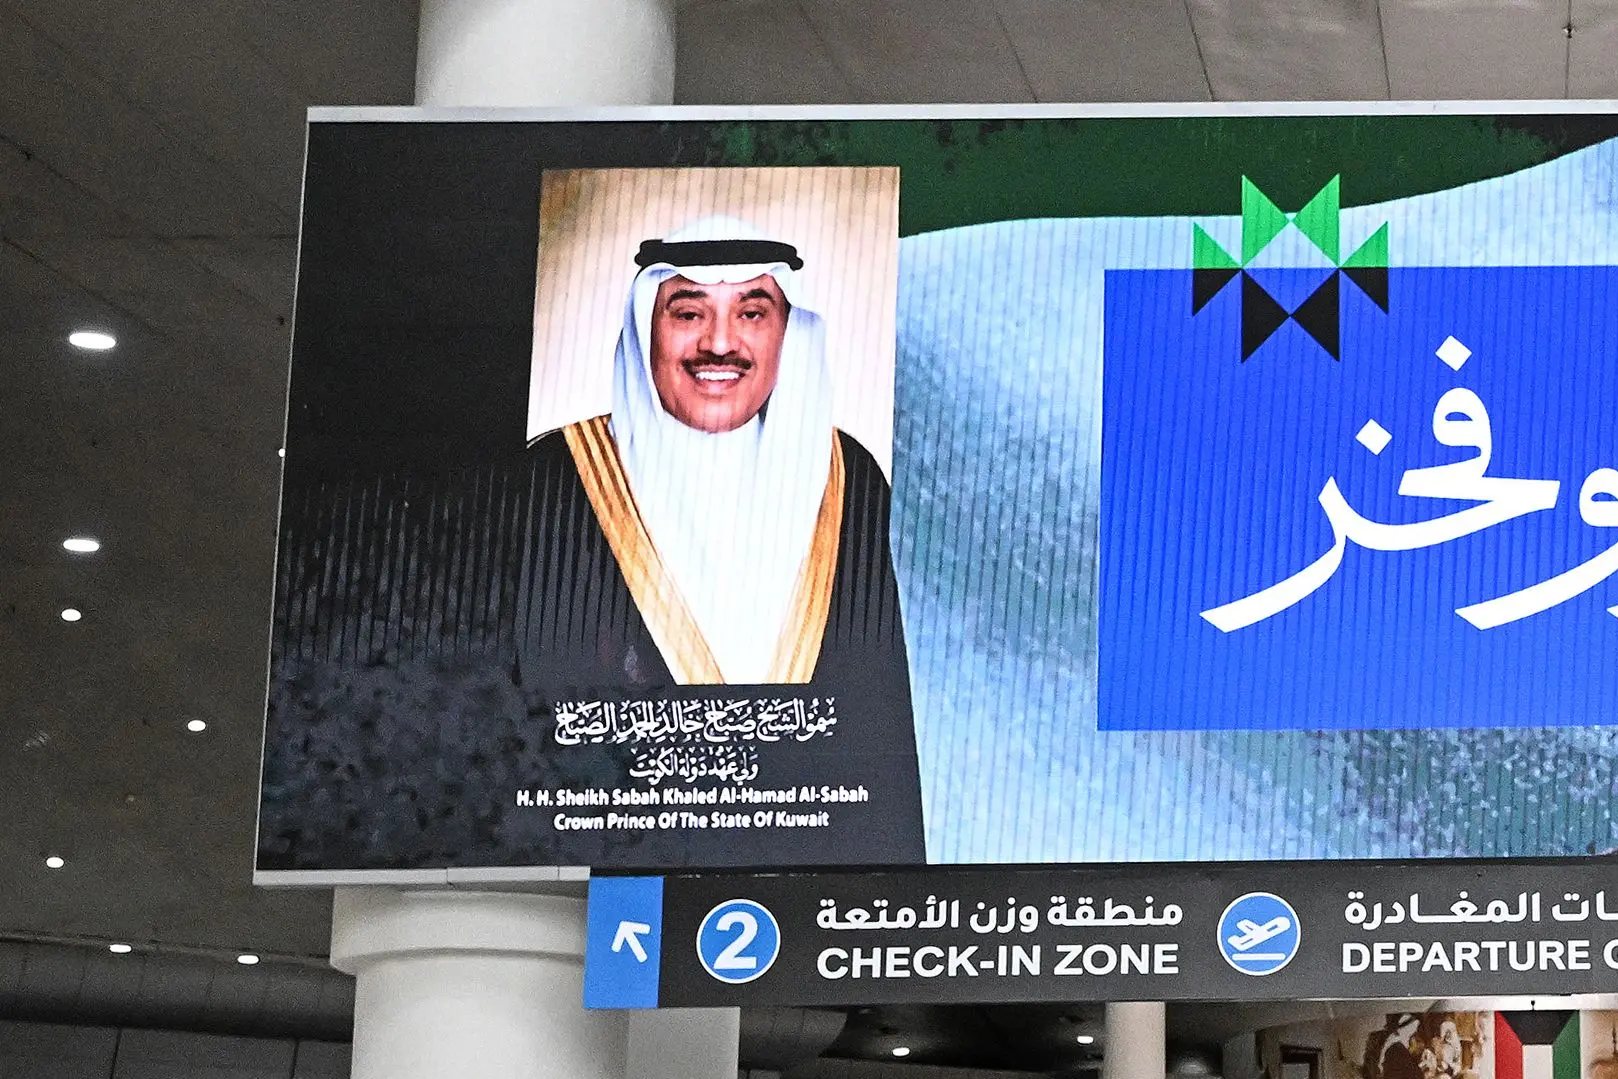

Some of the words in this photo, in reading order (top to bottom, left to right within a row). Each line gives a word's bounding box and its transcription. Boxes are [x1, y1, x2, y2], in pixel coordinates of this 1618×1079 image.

[556, 789, 609, 806] Sheikh
[613, 788, 660, 805] Sabah
[663, 787, 716, 805] Khaled
[720, 786, 796, 804] Al-Hamad
[799, 785, 869, 803] Al-Sabah
[554, 813, 604, 830] Crown
[607, 812, 655, 829] Prince
[658, 812, 678, 829] Of
[680, 812, 708, 829] The
[711, 811, 751, 828] State
[754, 810, 774, 828] Of
[776, 810, 830, 828] Kuwait
[816, 895, 959, 930] الأمتعة
[970, 897, 1039, 934] وزن
[1047, 896, 1183, 928] منطقة
[1345, 891, 1541, 931] المغادرة
[715, 911, 758, 970] 2
[1343, 940, 1592, 972] DEPARTURE
[817, 945, 1041, 979] CHECK-IN
[1054, 943, 1179, 976] ZONE
